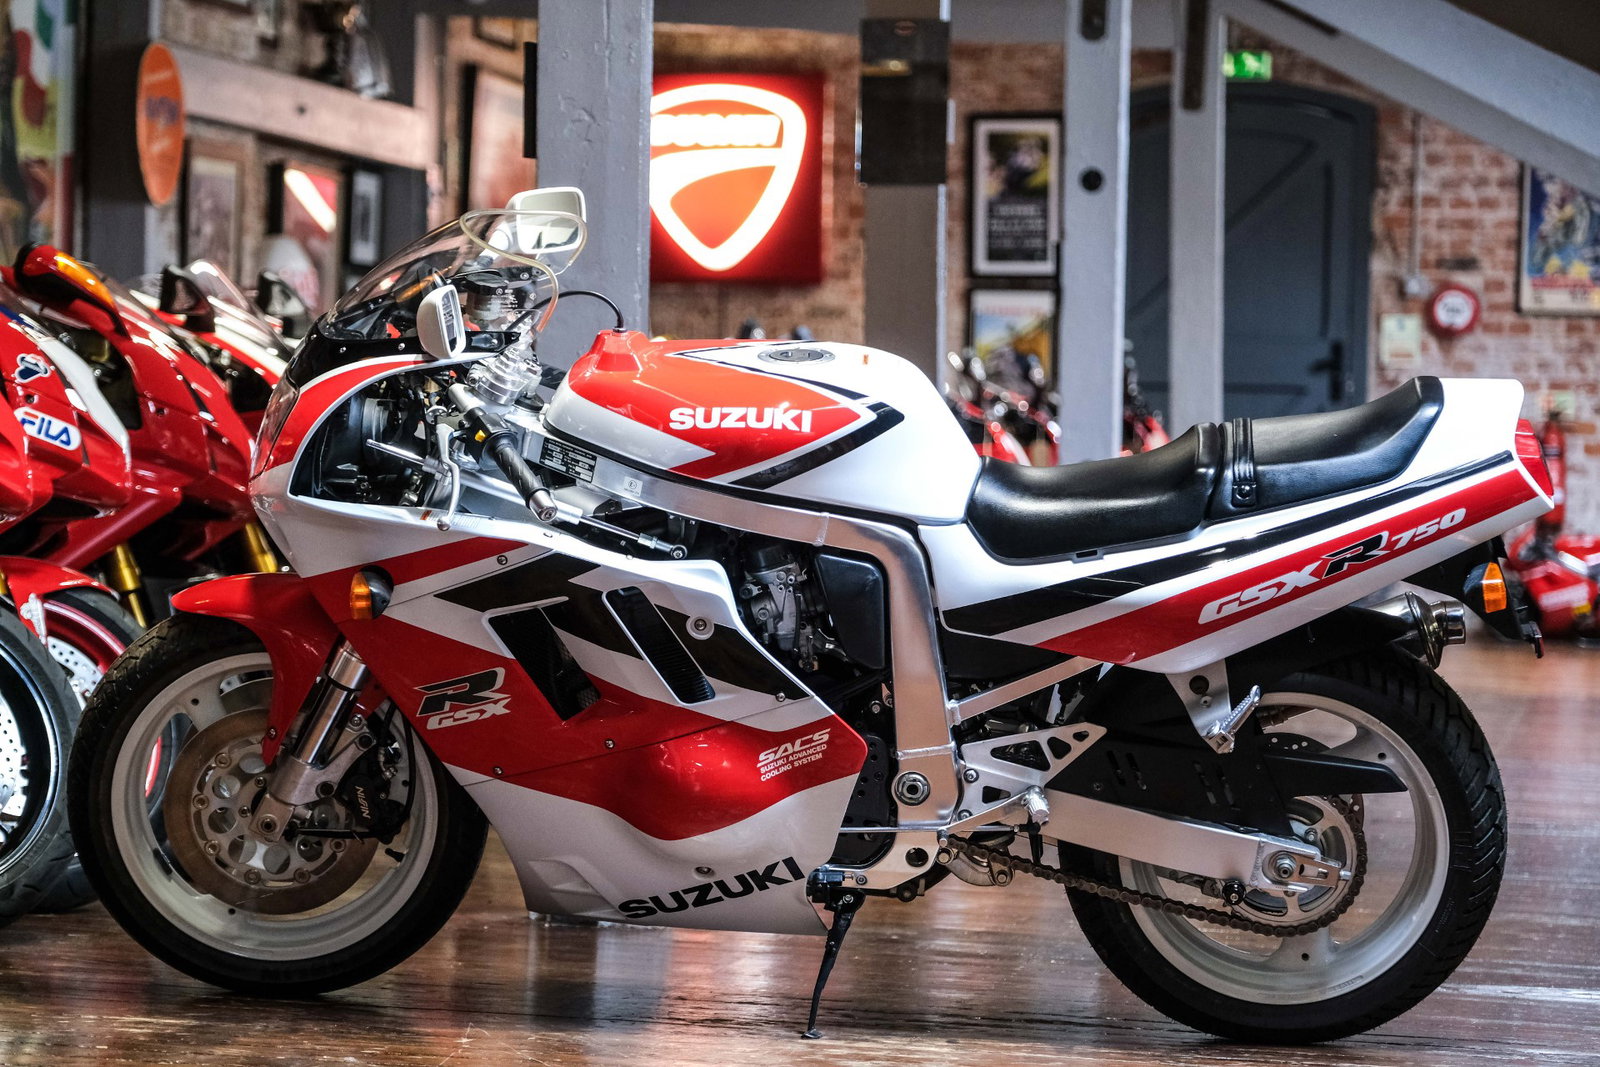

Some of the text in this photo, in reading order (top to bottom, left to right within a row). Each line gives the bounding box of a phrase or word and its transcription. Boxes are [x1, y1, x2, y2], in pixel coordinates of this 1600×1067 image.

[20, 411, 71, 446] FILA
[669, 407, 812, 433] SUZUKI
[413, 667, 511, 717] R
[426, 698, 512, 730] GSX
[756, 728, 831, 768] SACS
[760, 743, 827, 774] SUZUKI ADVANCED
[760, 752, 823, 782] COOLING SYSTEM
[618, 856, 806, 919] SUZUKI
